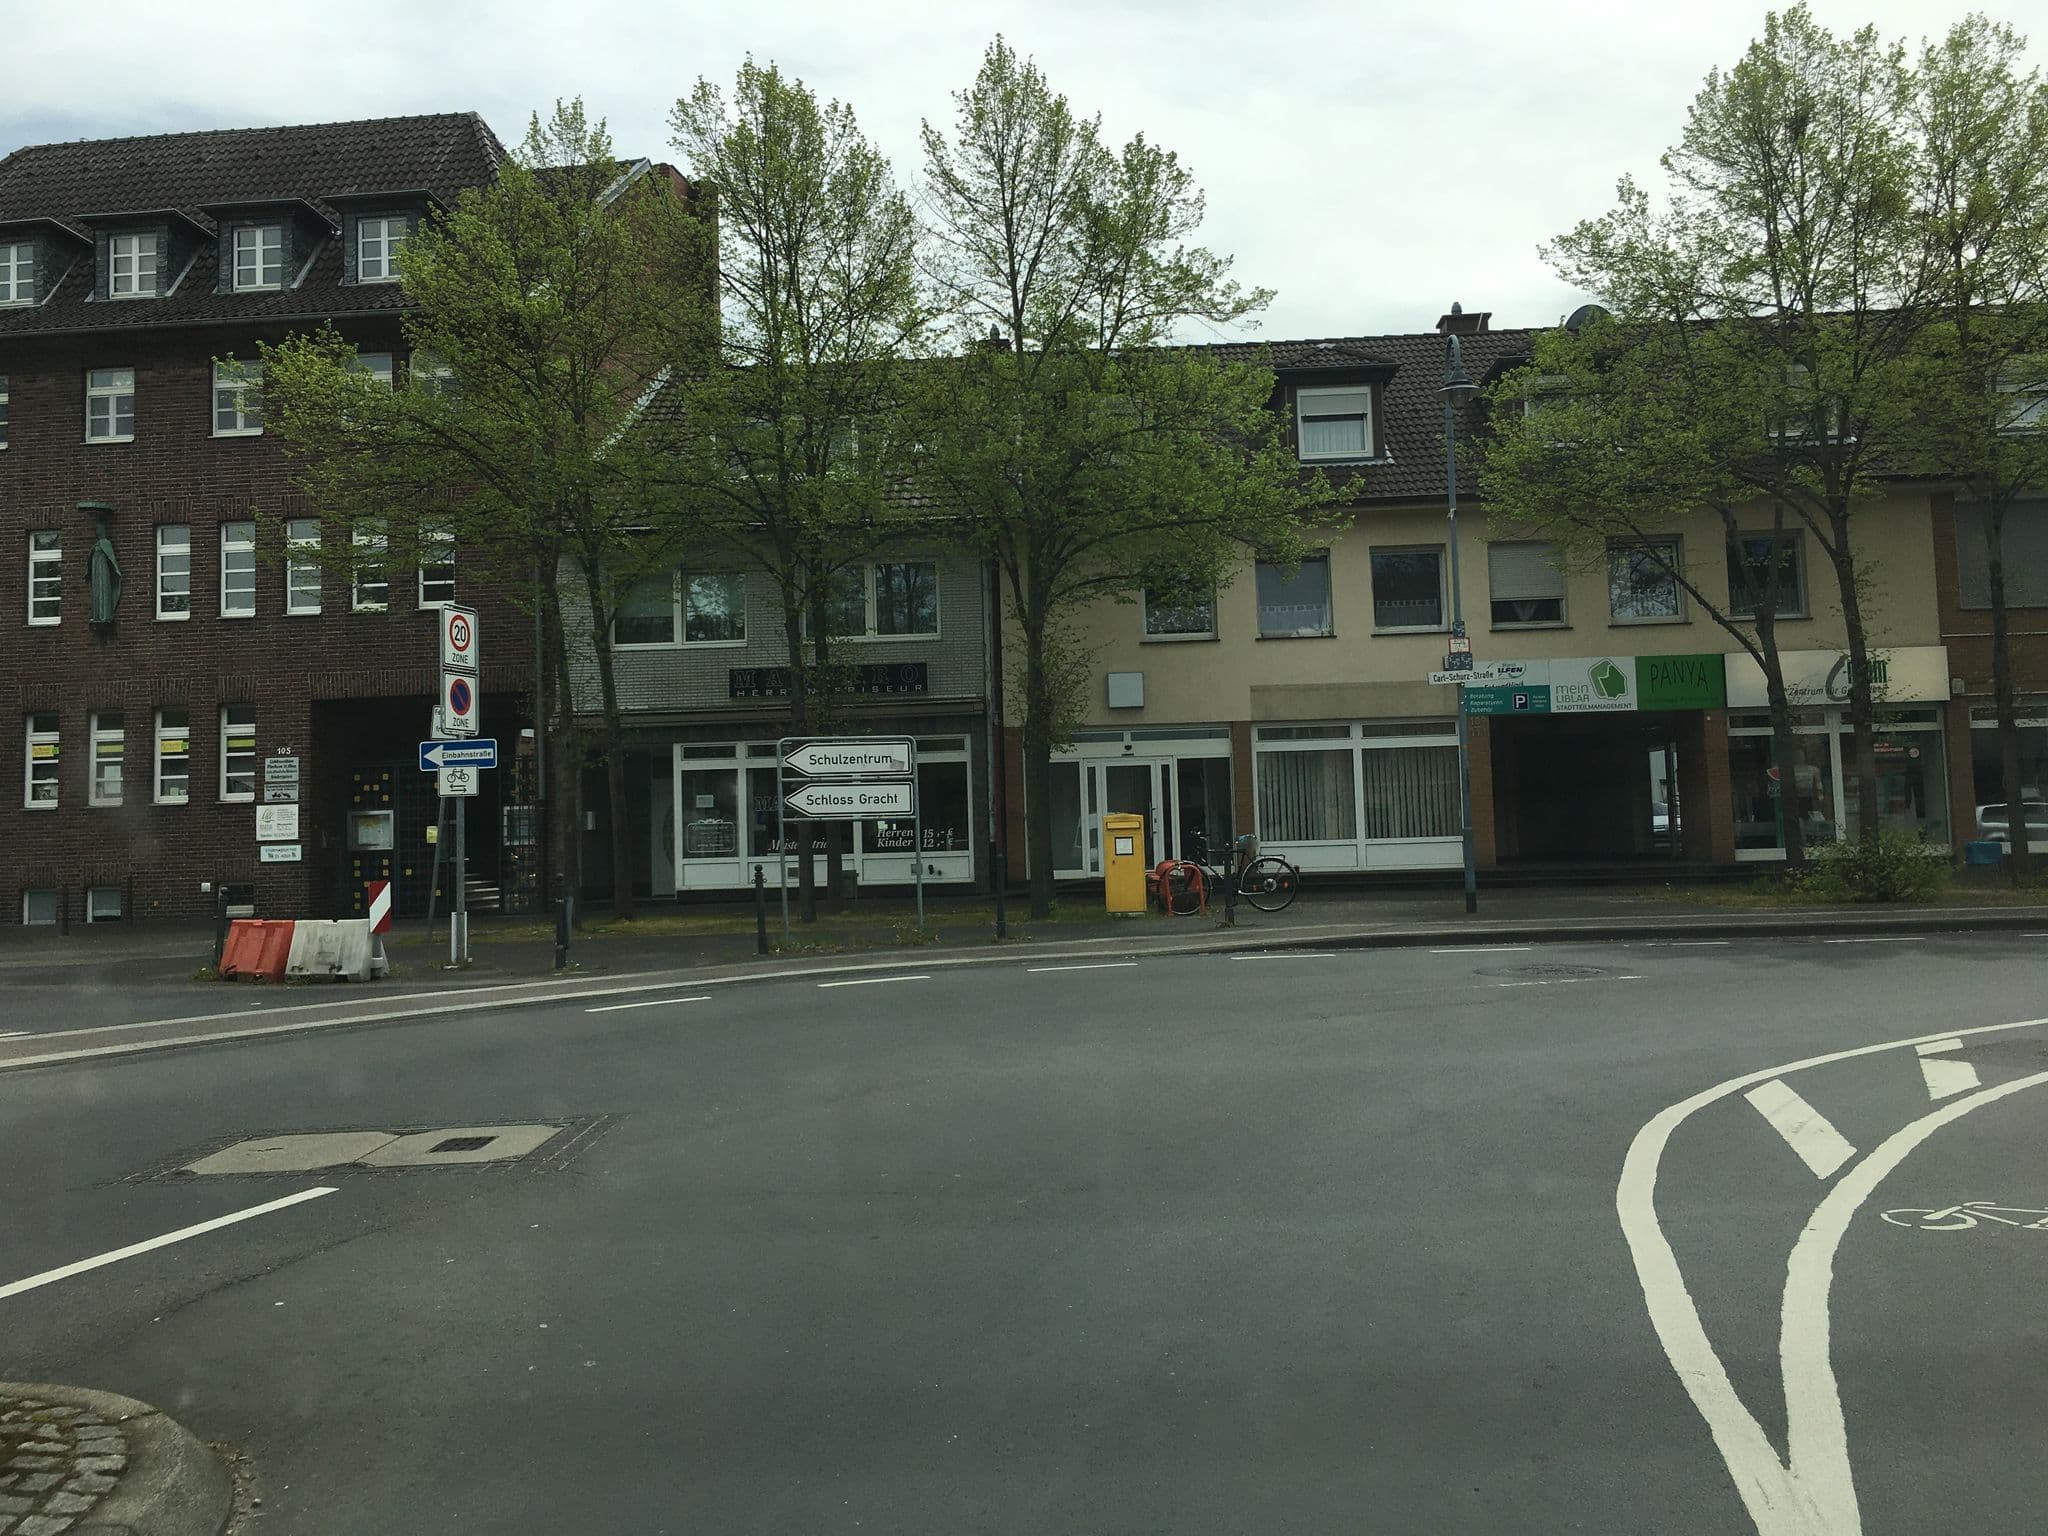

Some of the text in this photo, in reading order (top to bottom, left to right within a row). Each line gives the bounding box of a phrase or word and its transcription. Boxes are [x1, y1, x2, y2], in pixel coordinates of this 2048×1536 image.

[454, 624, 467, 643] 20
[452, 652, 469, 664] ZONE
[1433, 670, 1494, 683] Carl-Schurz-Straße
[1650, 659, 1709, 693] PANYA
[736, 688, 816, 697] HERRN
[1555, 684, 1589, 695] mein
[1556, 693, 1590, 704] LIBLAR
[1556, 702, 1632, 711] STADTTEILMANAGEMENT
[452, 717, 469, 728] ZONE
[277, 747, 291, 755] 105
[441, 750, 492, 760] Einbahnstraße
[809, 753, 893, 765] Schulzentrum
[806, 794, 854, 805] Schloss
[859, 793, 898, 804] Gracht
[877, 829, 914, 838] Herren
[877, 838, 914, 847] Kinder
